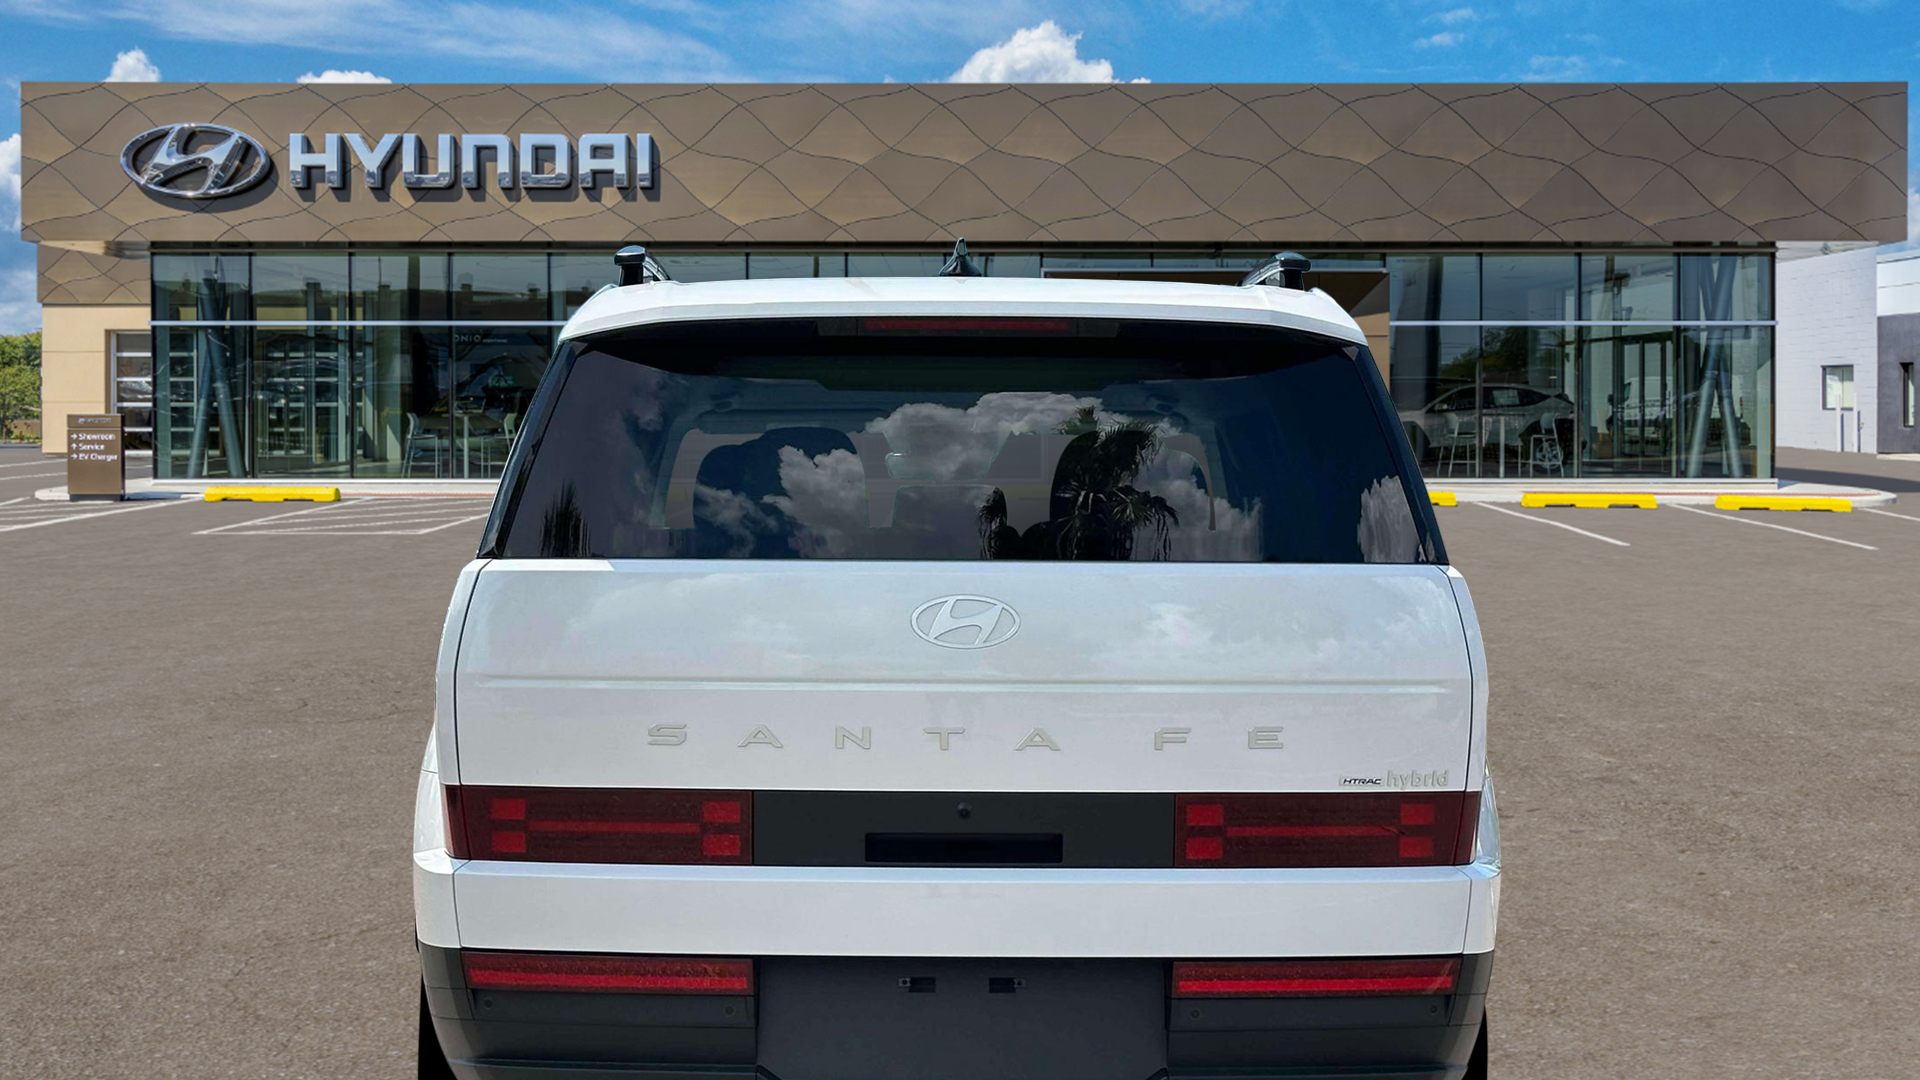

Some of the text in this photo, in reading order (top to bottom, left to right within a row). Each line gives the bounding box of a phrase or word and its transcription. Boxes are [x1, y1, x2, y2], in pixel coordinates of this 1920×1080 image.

[289, 133, 655, 189] HYUNDAI
[78, 442, 105, 450] Service
[90, 453, 118, 462] Charger
[647, 724, 1285, 751] SANTA FE
[1386, 769, 1449, 790] hybrid
